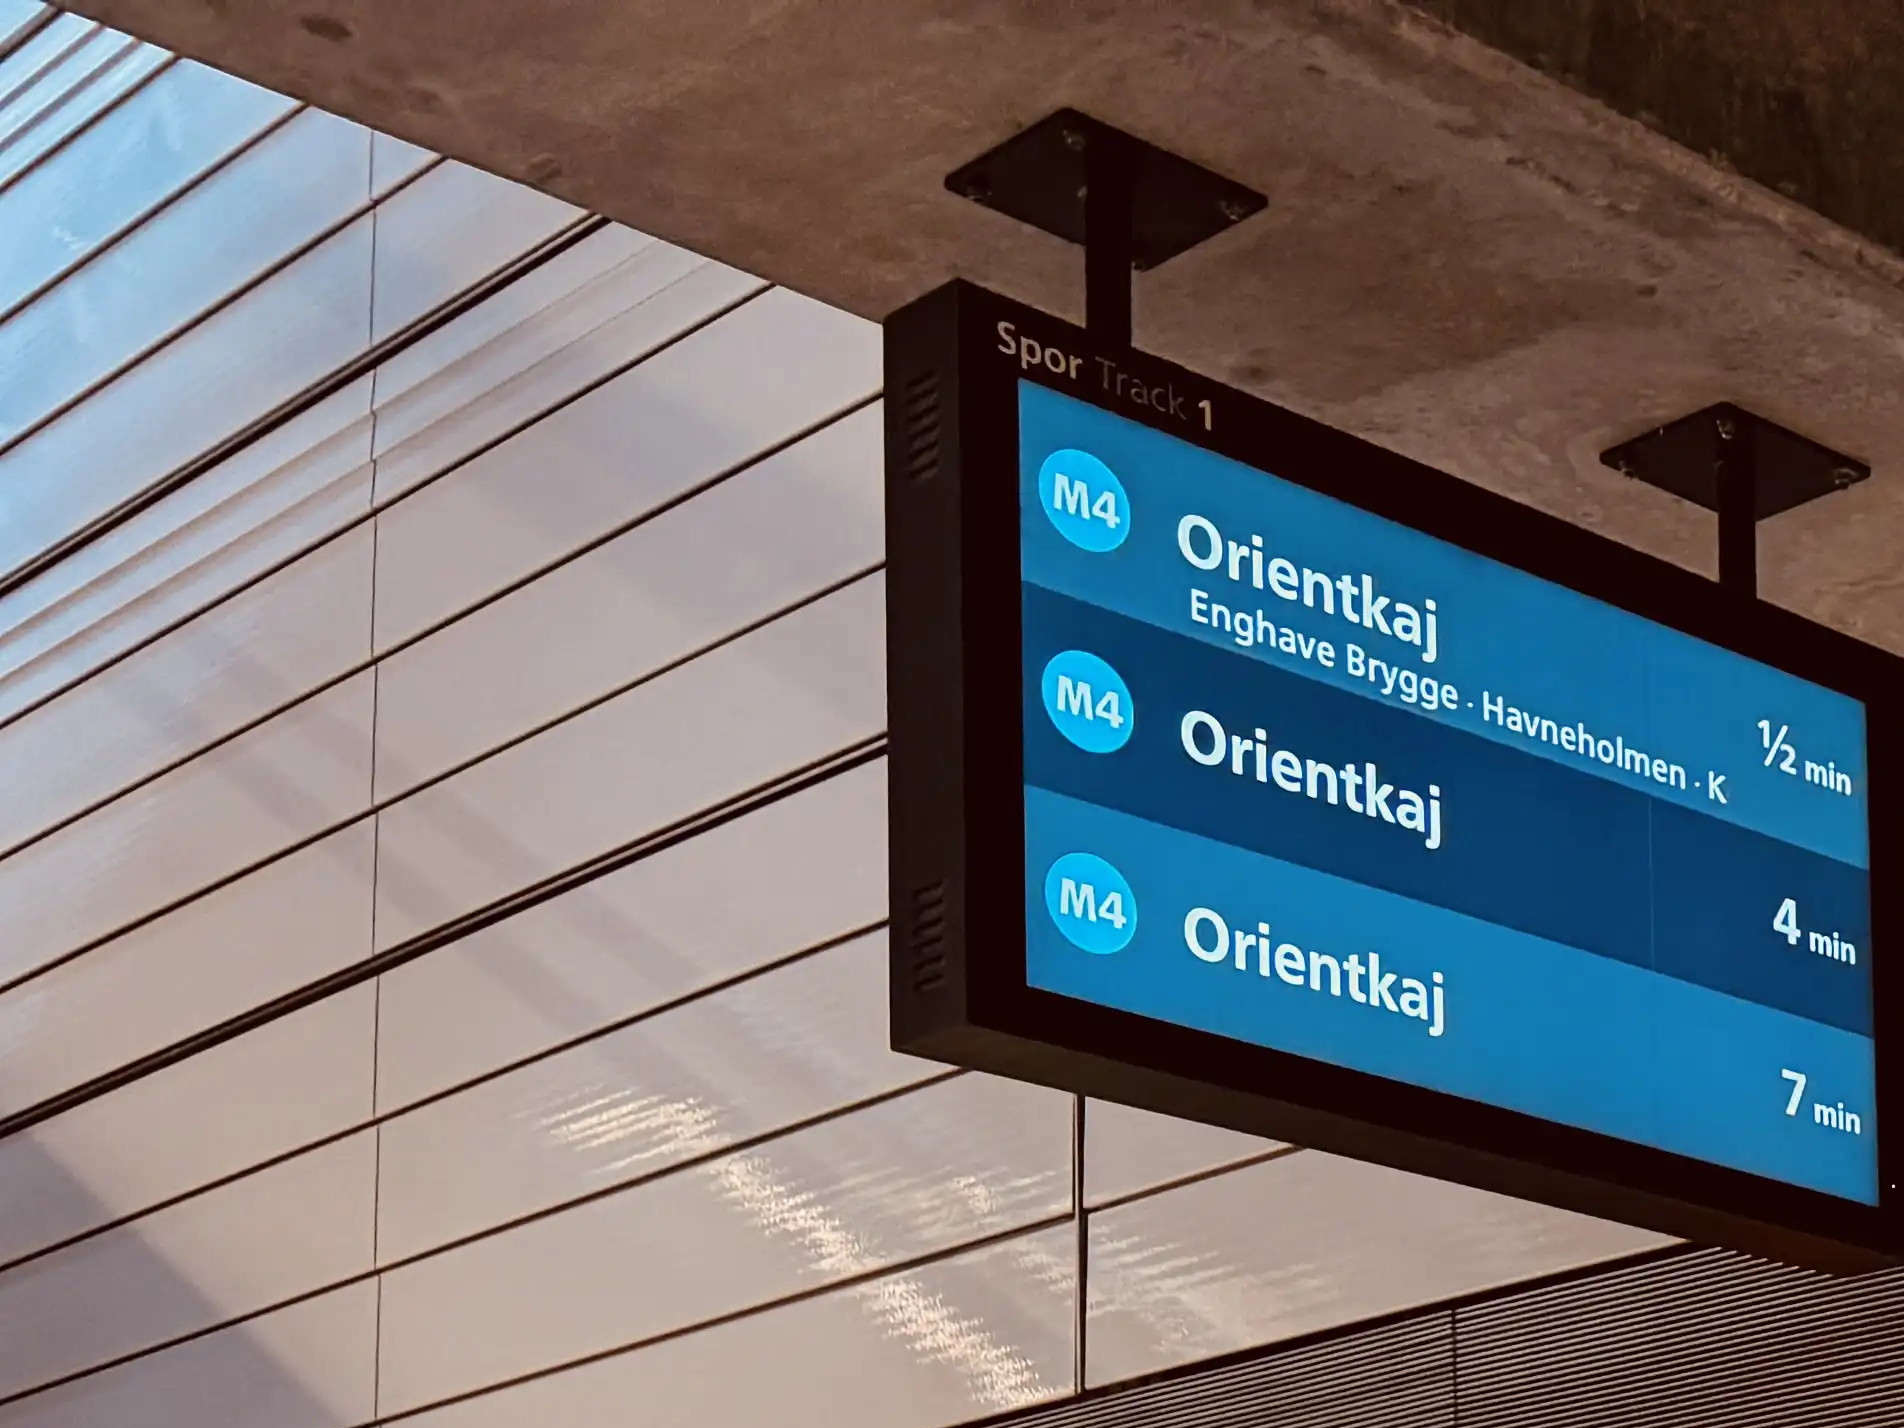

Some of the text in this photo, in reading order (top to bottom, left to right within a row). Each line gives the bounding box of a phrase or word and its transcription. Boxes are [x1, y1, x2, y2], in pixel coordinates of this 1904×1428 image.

[996, 320, 1213, 432] Spor Track 1
[1052, 472, 1122, 530] M4
[1176, 513, 1438, 664] Orientkaj
[1803, 759, 1853, 797] min
[1189, 587, 1728, 805] Enghave Brygge Havneholmen K
[1056, 674, 1857, 966] M4 Orientkaj 4 min
[1059, 877, 1862, 1136] M4 Orientkaj 7 min
